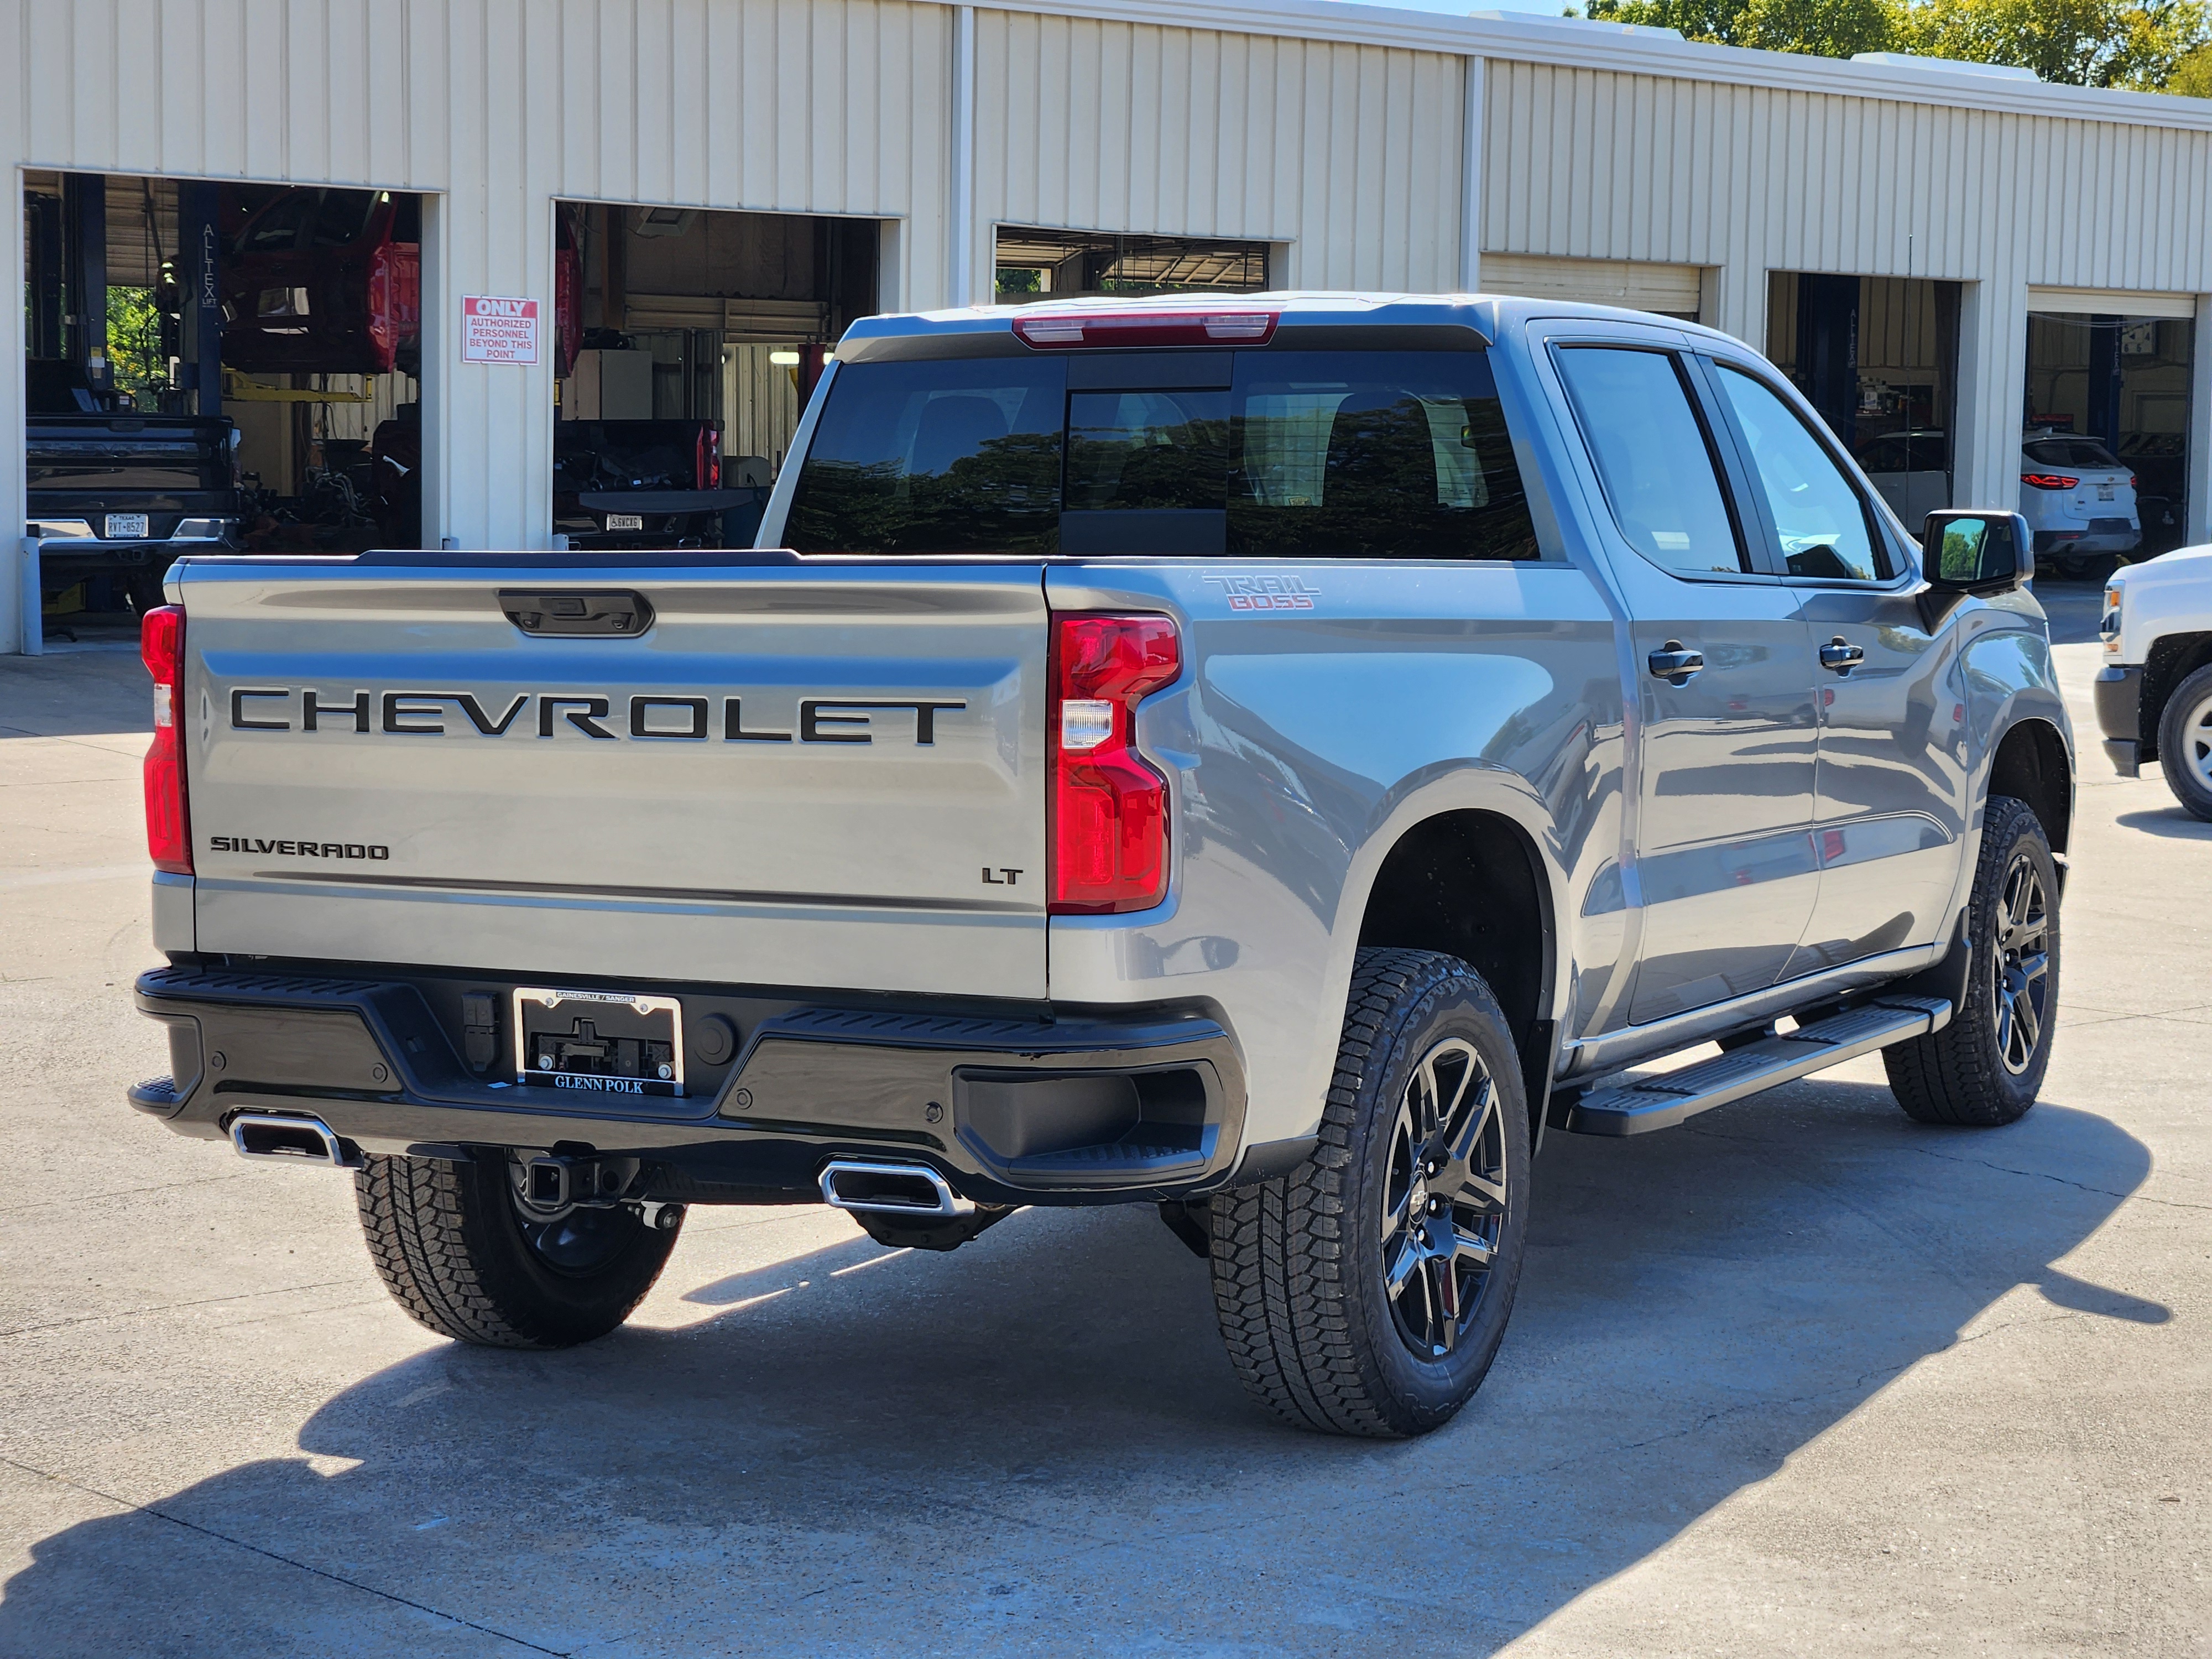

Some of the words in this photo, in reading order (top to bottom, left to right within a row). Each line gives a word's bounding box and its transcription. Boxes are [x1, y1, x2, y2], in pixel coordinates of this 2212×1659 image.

[204, 223, 214, 298] ALLTEX
[476, 299, 526, 317] ONLY
[471, 318, 531, 328] AUTHORIZED
[473, 328, 529, 338] PERSONNEL
[469, 338, 508, 348] BEYOND
[511, 340, 532, 349] THIS
[487, 349, 515, 358] POINT
[1201, 575, 1322, 595] TRAIL
[1227, 594, 1314, 611] BOSS
[230, 687, 967, 744] CHEVROLET
[210, 837, 389, 860] SILVERADO
[982, 867, 1024, 885] LT
[557, 992, 600, 1000] GAINESVILLE
[555, 1076, 603, 1091] GLENN
[605, 1079, 643, 1094] POLK
